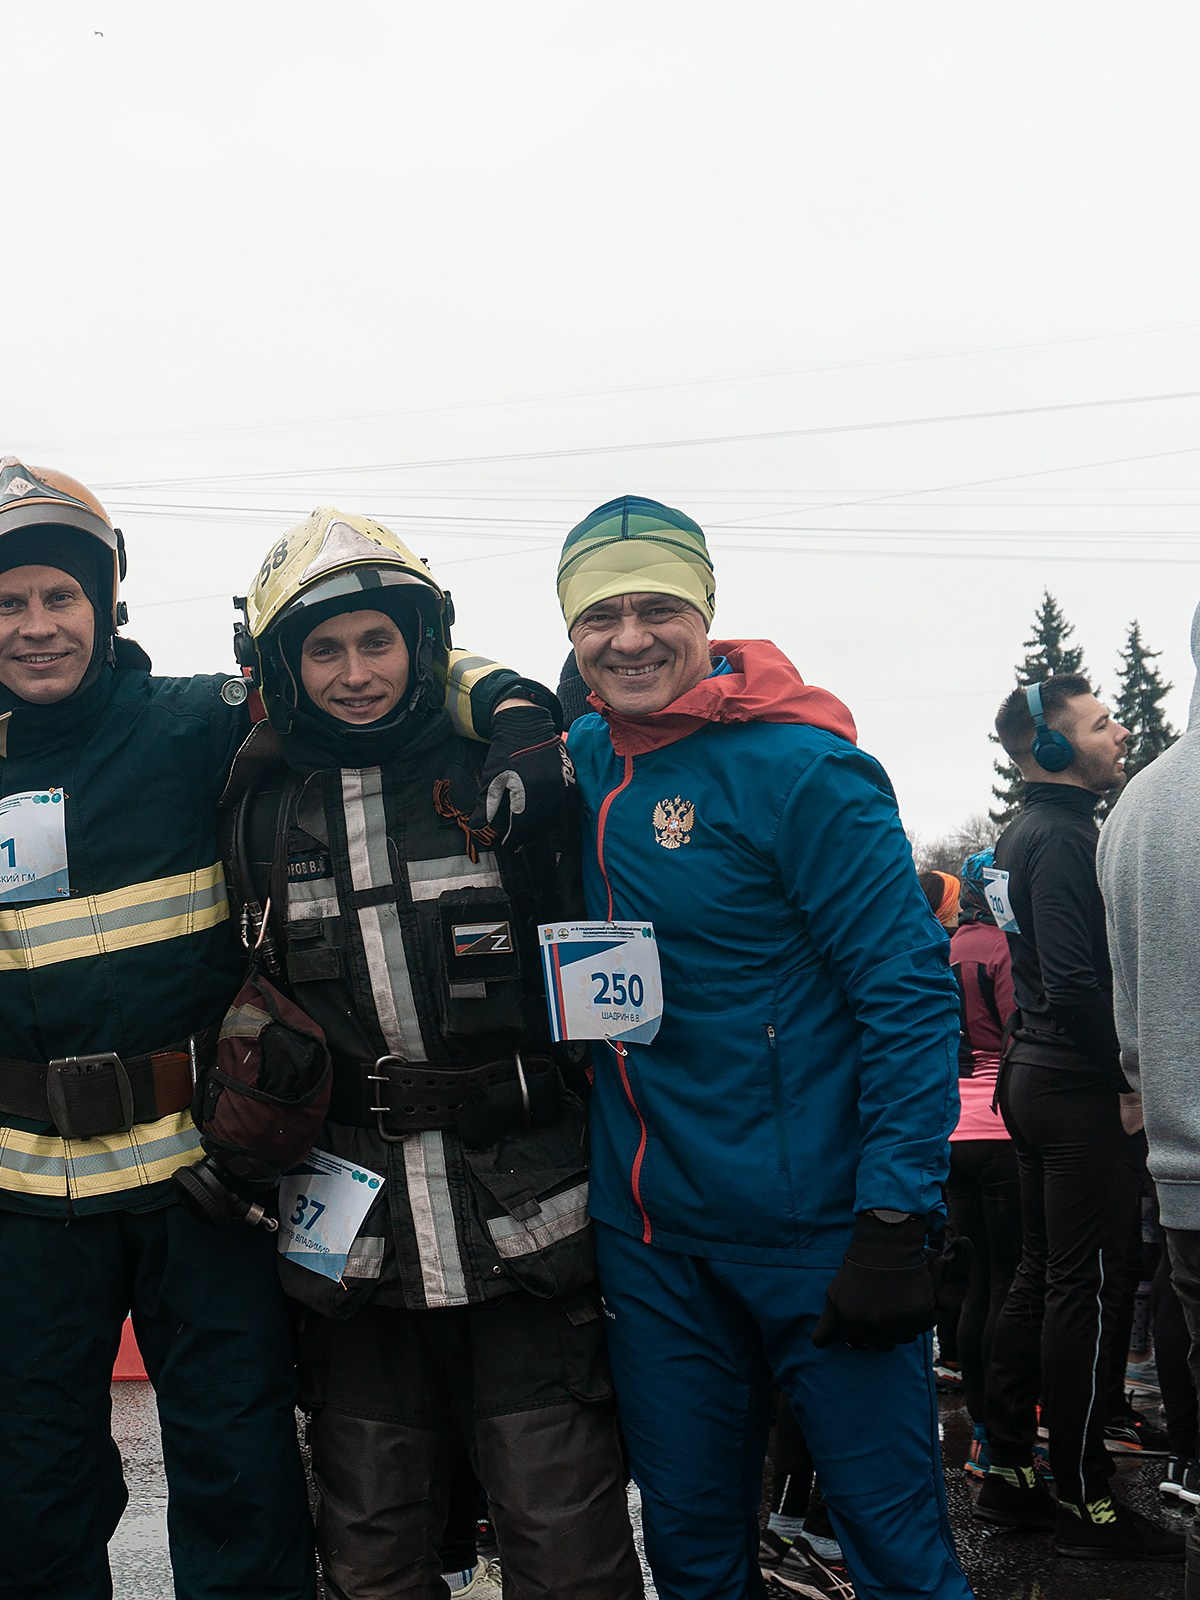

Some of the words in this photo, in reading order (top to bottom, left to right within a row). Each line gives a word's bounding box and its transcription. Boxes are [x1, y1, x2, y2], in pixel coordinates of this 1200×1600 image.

[260, 541, 288, 588] 58
[490, 934, 510, 951] Z
[591, 972, 644, 1008] 250
[290, 1194, 326, 1231] 37
